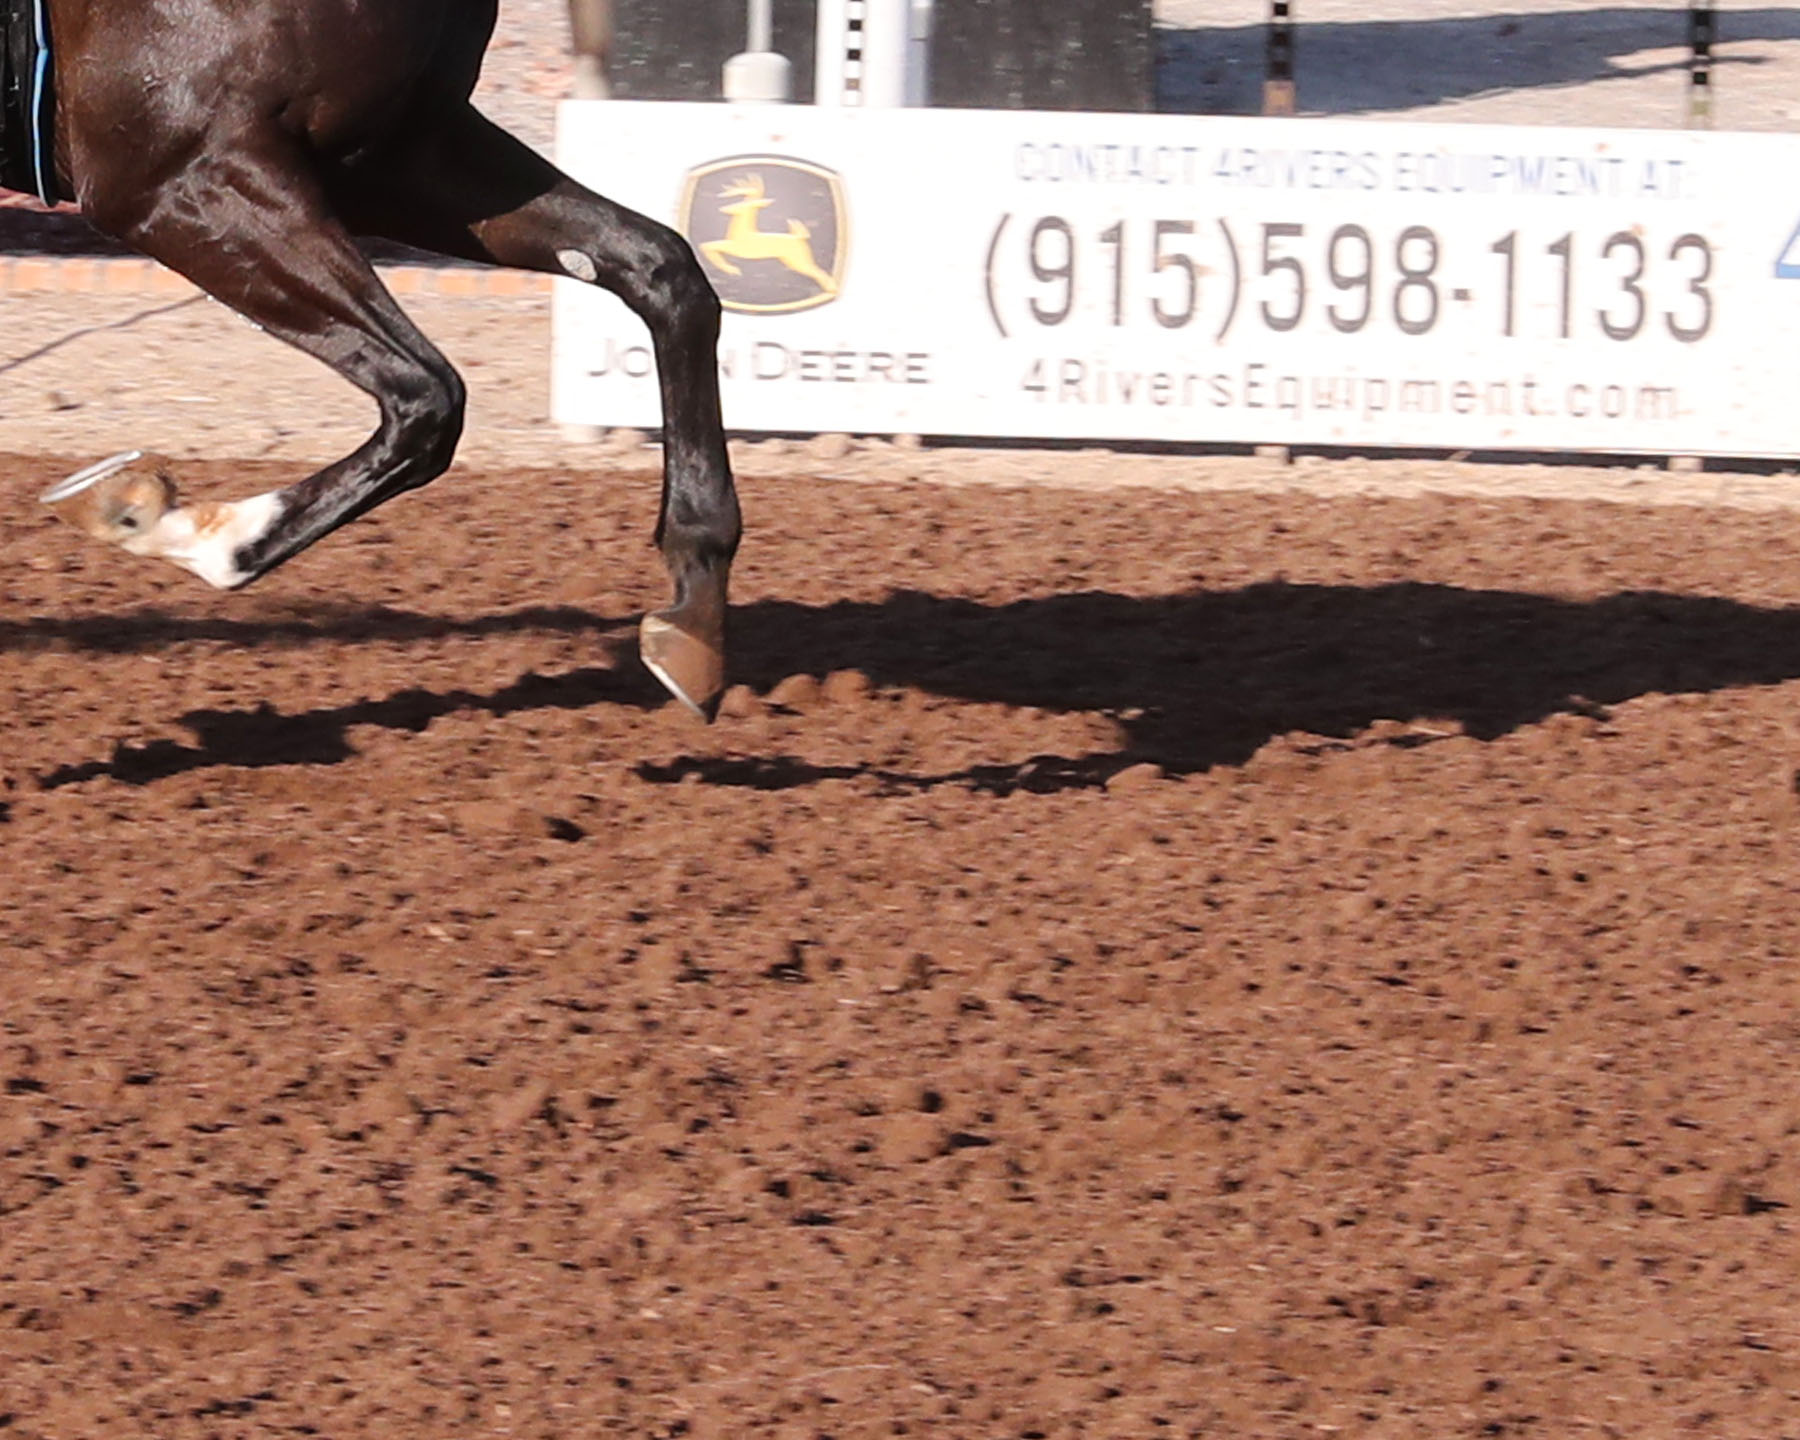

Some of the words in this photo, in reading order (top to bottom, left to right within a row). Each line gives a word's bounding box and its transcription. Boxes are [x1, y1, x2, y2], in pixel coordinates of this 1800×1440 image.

[1013, 142, 1200, 186] CONTACT
[1394, 152, 1630, 197] EQUIPMENT
[985, 213, 1714, 343] (915)598-1133
[587, 338, 736, 384] JON
[753, 342, 932, 386] DEERE
[1020, 359, 1678, 422] 4RiversEquipment.com
